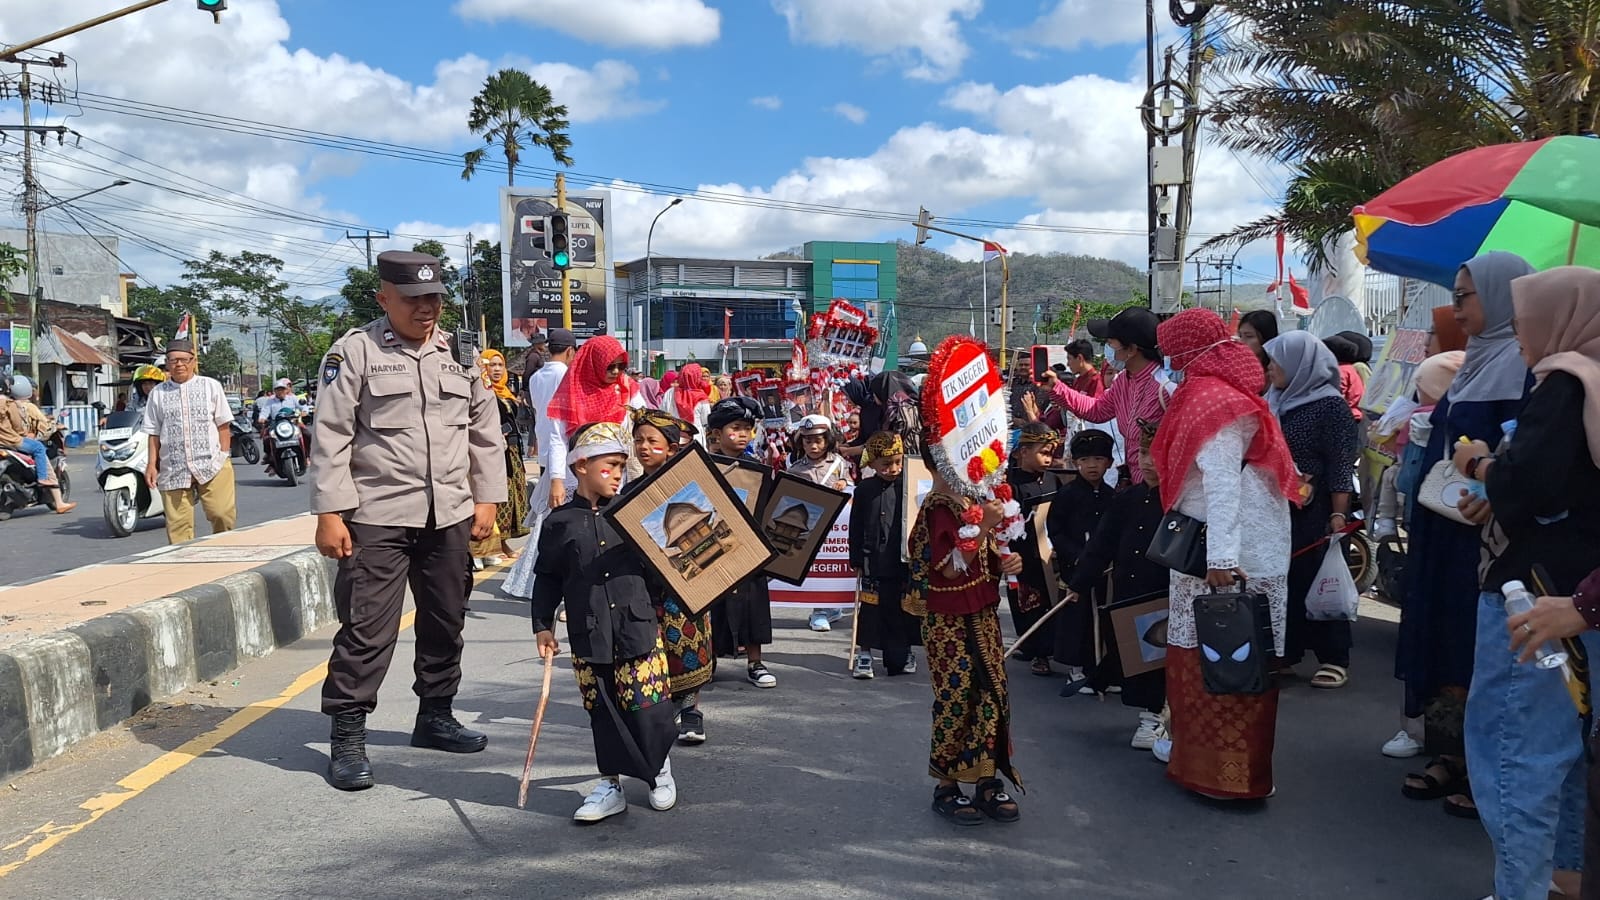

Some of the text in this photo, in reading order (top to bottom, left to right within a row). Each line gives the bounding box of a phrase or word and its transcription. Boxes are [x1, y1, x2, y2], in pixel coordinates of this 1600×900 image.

[585, 201, 602, 209] NEW
[541, 280, 550, 288] 12
[371, 364, 407, 373] HARYADI
[944, 359, 986, 398] TK NEGERI
[970, 402, 977, 417] 1
[960, 418, 998, 461] GERUNG
